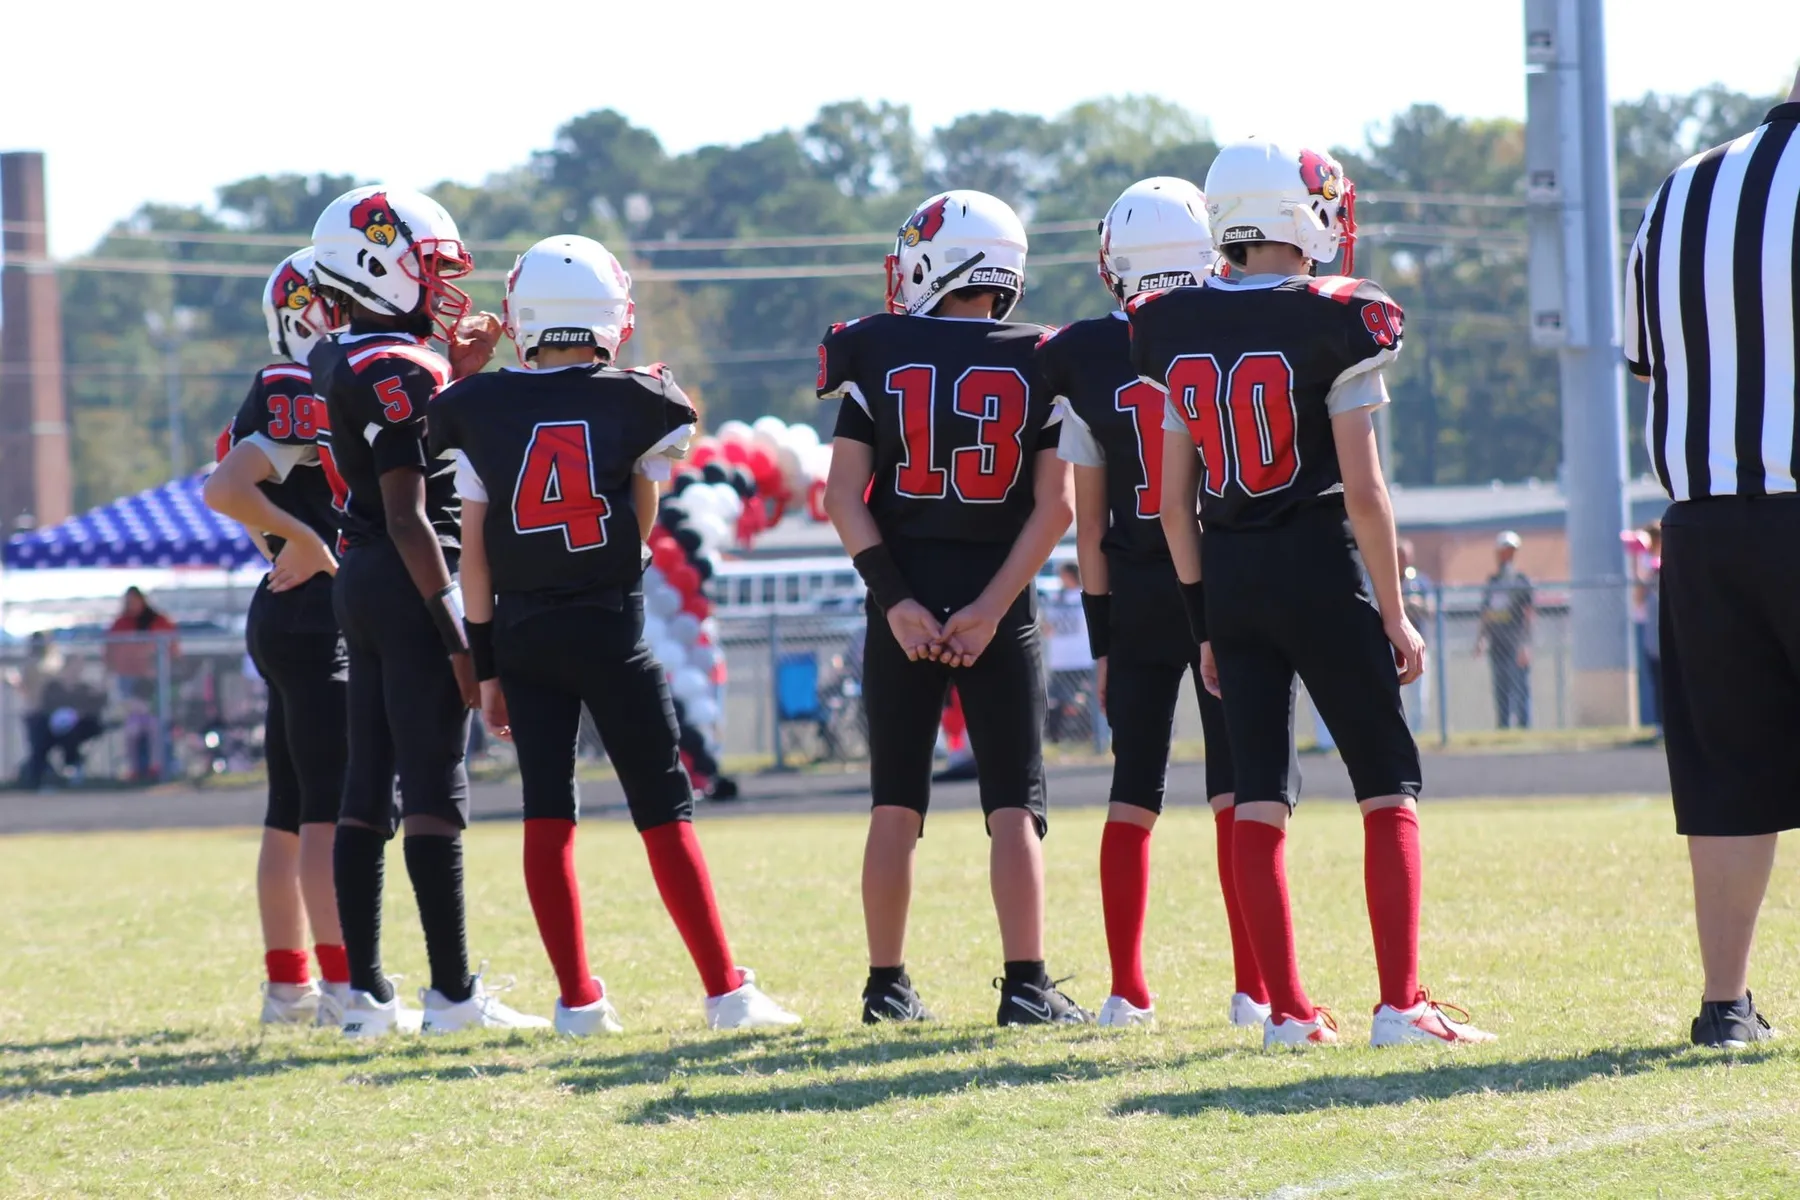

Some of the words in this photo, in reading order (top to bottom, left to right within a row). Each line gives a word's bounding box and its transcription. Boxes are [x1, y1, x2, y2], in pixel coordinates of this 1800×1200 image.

[1225, 228, 1258, 240] schutt
[971, 268, 1016, 285] schutt
[1141, 273, 1192, 290] schutt
[544, 330, 590, 342] schutt
[373, 376, 413, 423] 5
[886, 364, 1029, 504] 13
[1115, 377, 1166, 519] 1
[1165, 351, 1301, 498] 90
[511, 420, 611, 552] 4
